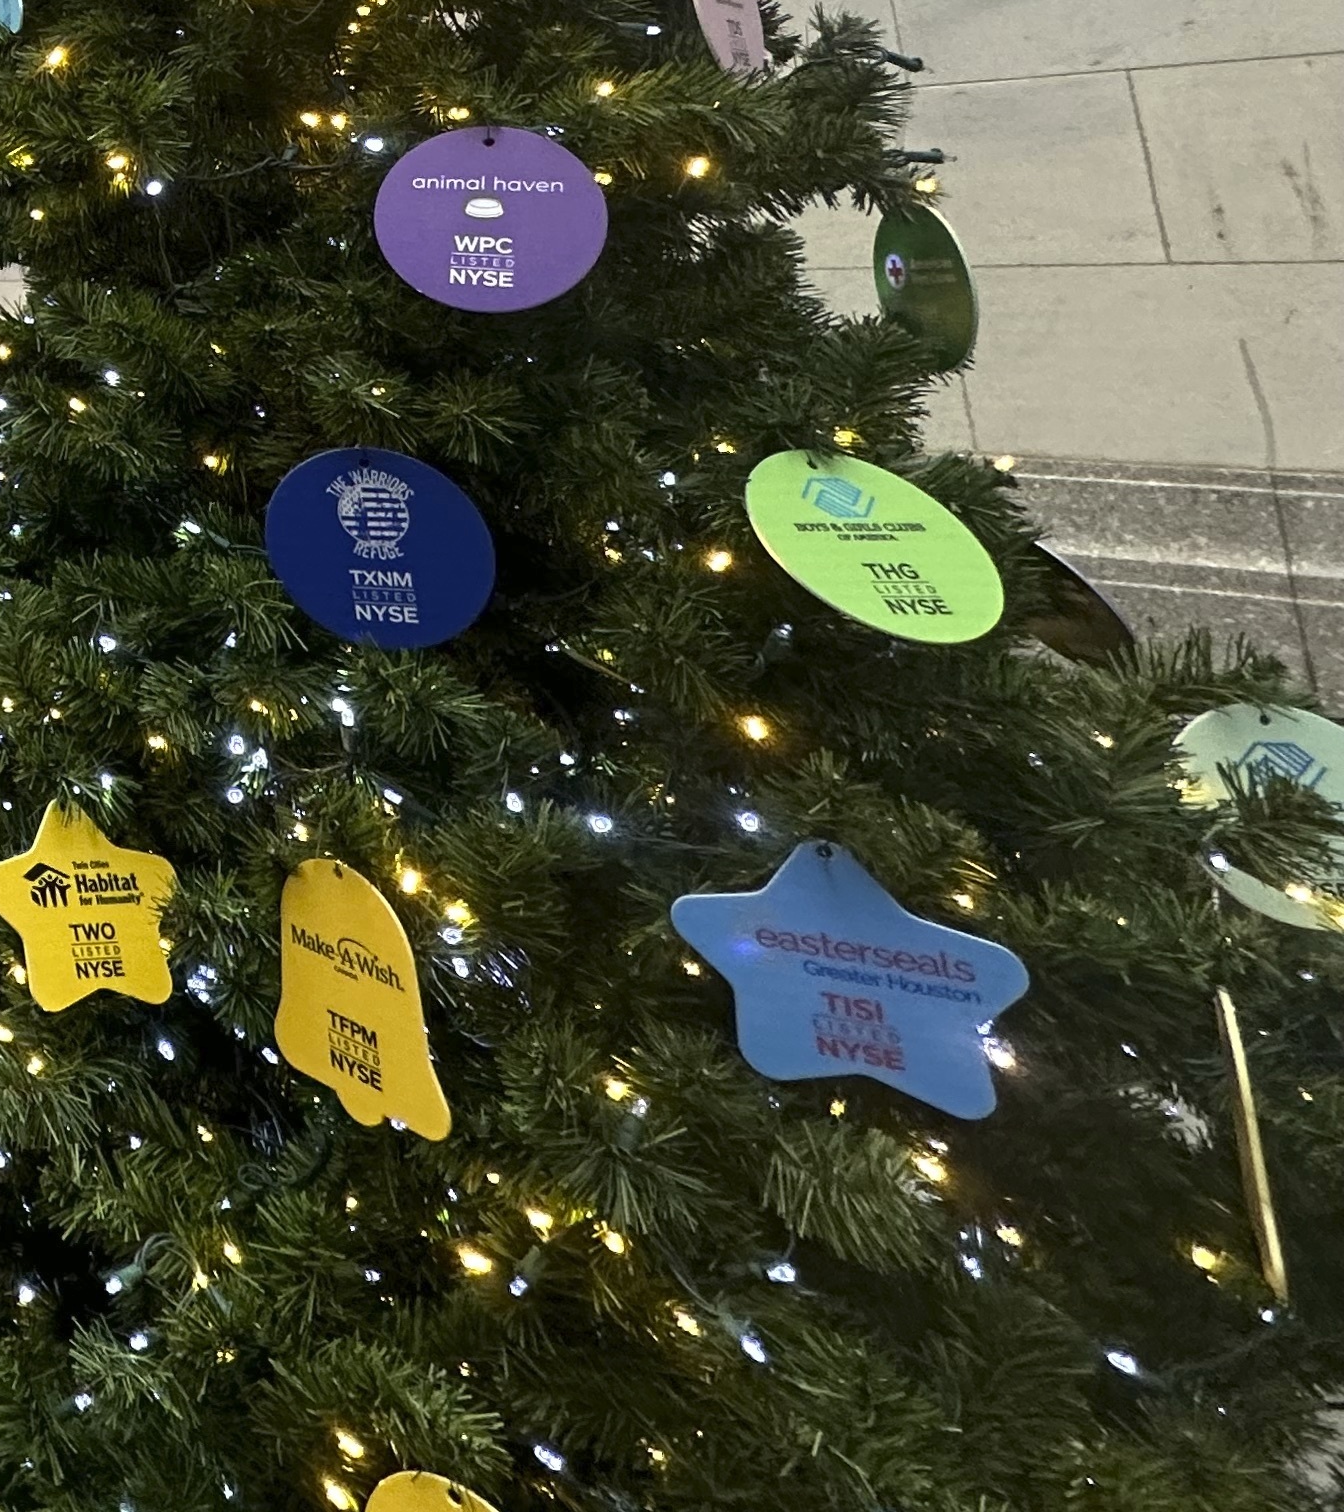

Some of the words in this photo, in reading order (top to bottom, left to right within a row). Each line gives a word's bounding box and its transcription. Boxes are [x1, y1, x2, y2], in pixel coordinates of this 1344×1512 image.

[412, 175, 486, 191] animal
[493, 176, 564, 193] haven
[454, 236, 513, 254] WPC
[450, 255, 515, 268] LISTED
[449, 269, 514, 288] NYSE
[326, 474, 348, 499] THE
[348, 468, 415, 501] WARRIORS
[353, 541, 404, 561] REFUGE
[349, 569, 413, 588] TXNM
[861, 563, 920, 580] THG
[352, 590, 417, 603] LISTED
[873, 585, 937, 594] LISTED
[354, 605, 419, 624] NYSE
[883, 599, 953, 615] NYSE
[74, 873, 140, 893] Habitat
[79, 895, 92, 906] for
[96, 893, 142, 906] Humanity
[69, 922, 116, 942] TWO
[72, 946, 121, 958] LISTED
[754, 927, 976, 983] easterseals
[76, 960, 125, 979] NYSE
[803, 960, 880, 988] Greater
[886, 974, 982, 1006] Houston
[821, 991, 884, 1022] TISI
[327, 1009, 378, 1050] TFPM
[329, 1032, 380, 1066] LISTED
[816, 1037, 906, 1071] NYSE
[331, 1053, 383, 1093] NYSE
